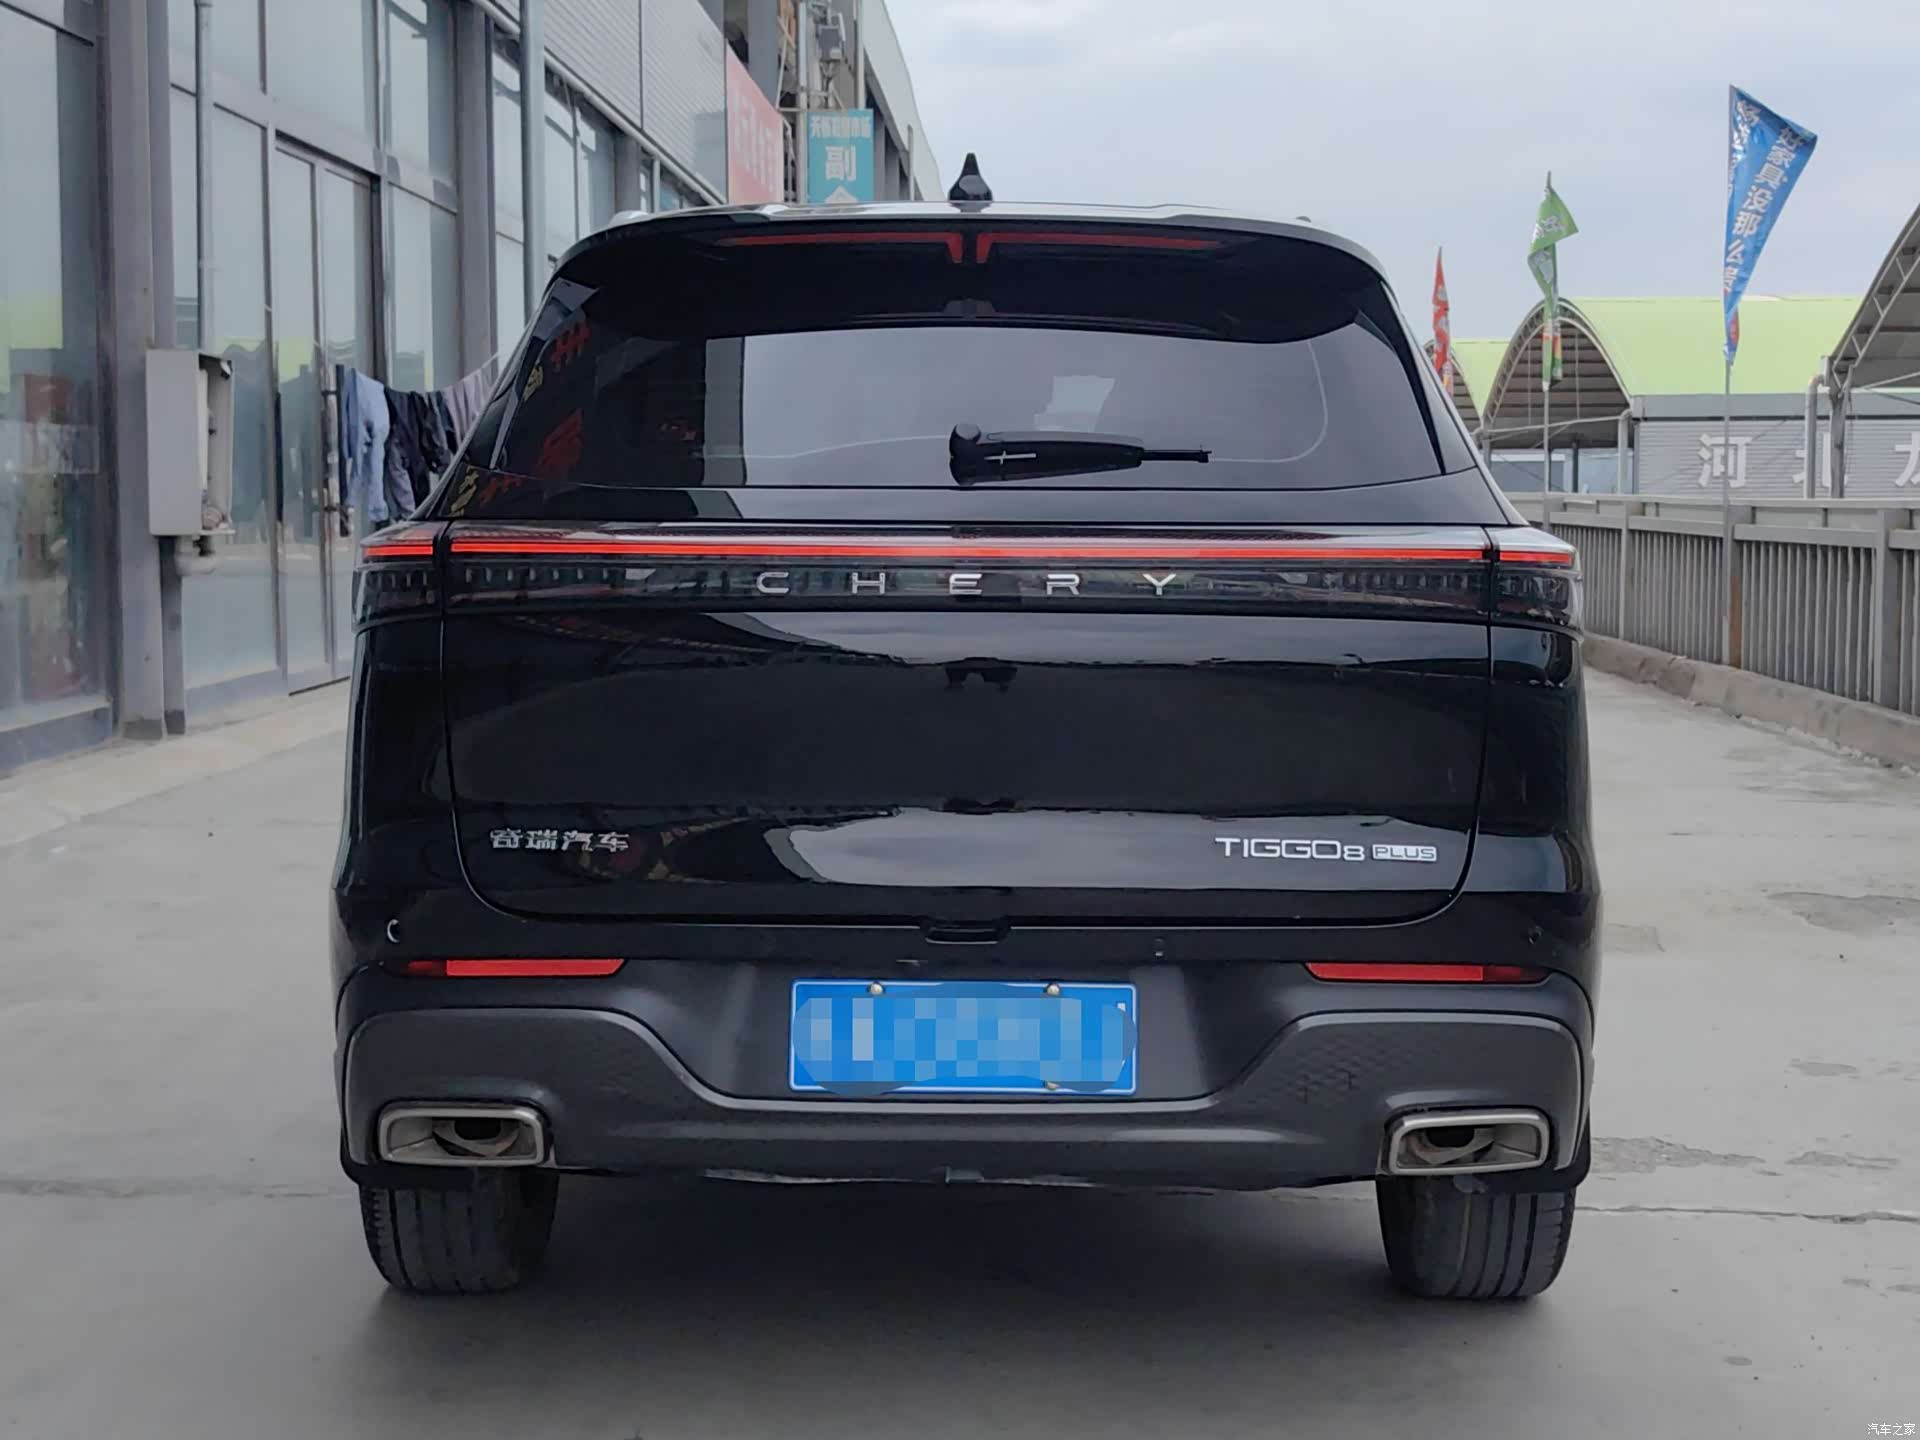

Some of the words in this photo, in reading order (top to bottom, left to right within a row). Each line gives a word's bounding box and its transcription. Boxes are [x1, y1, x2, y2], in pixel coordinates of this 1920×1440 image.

[756, 571, 1177, 595] CHERY
[490, 828, 629, 852] 奇瑞汽车
[1374, 845, 1436, 860] PLUS
